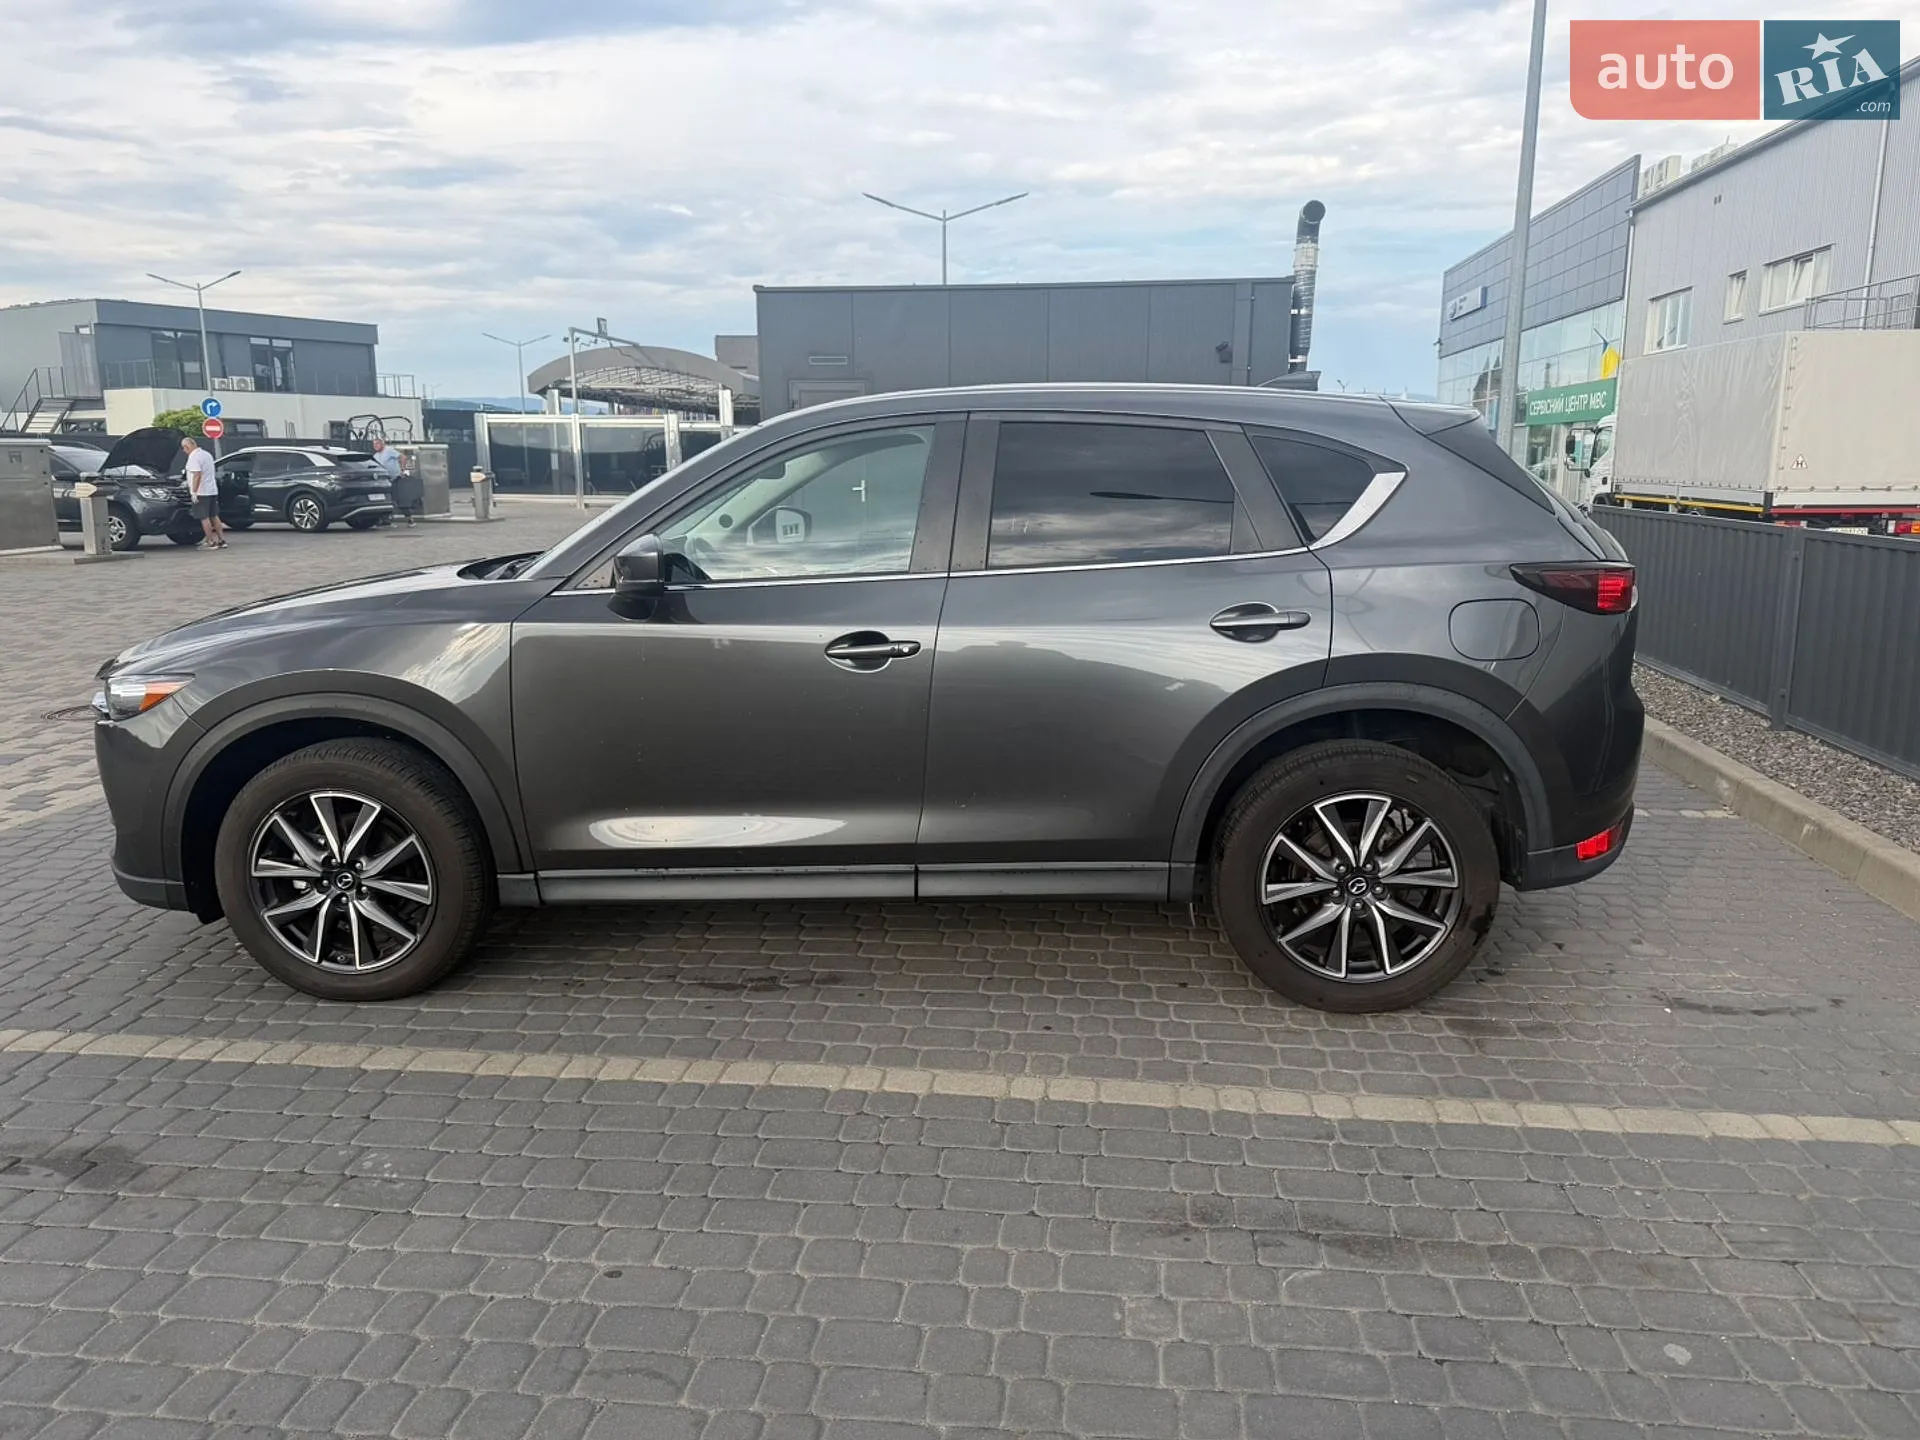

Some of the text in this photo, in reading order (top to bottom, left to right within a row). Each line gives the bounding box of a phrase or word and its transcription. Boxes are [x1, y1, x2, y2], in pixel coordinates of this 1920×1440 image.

[1529, 390, 1607, 416] СЕРВІСНИЙ ЦЕНТР МВС
